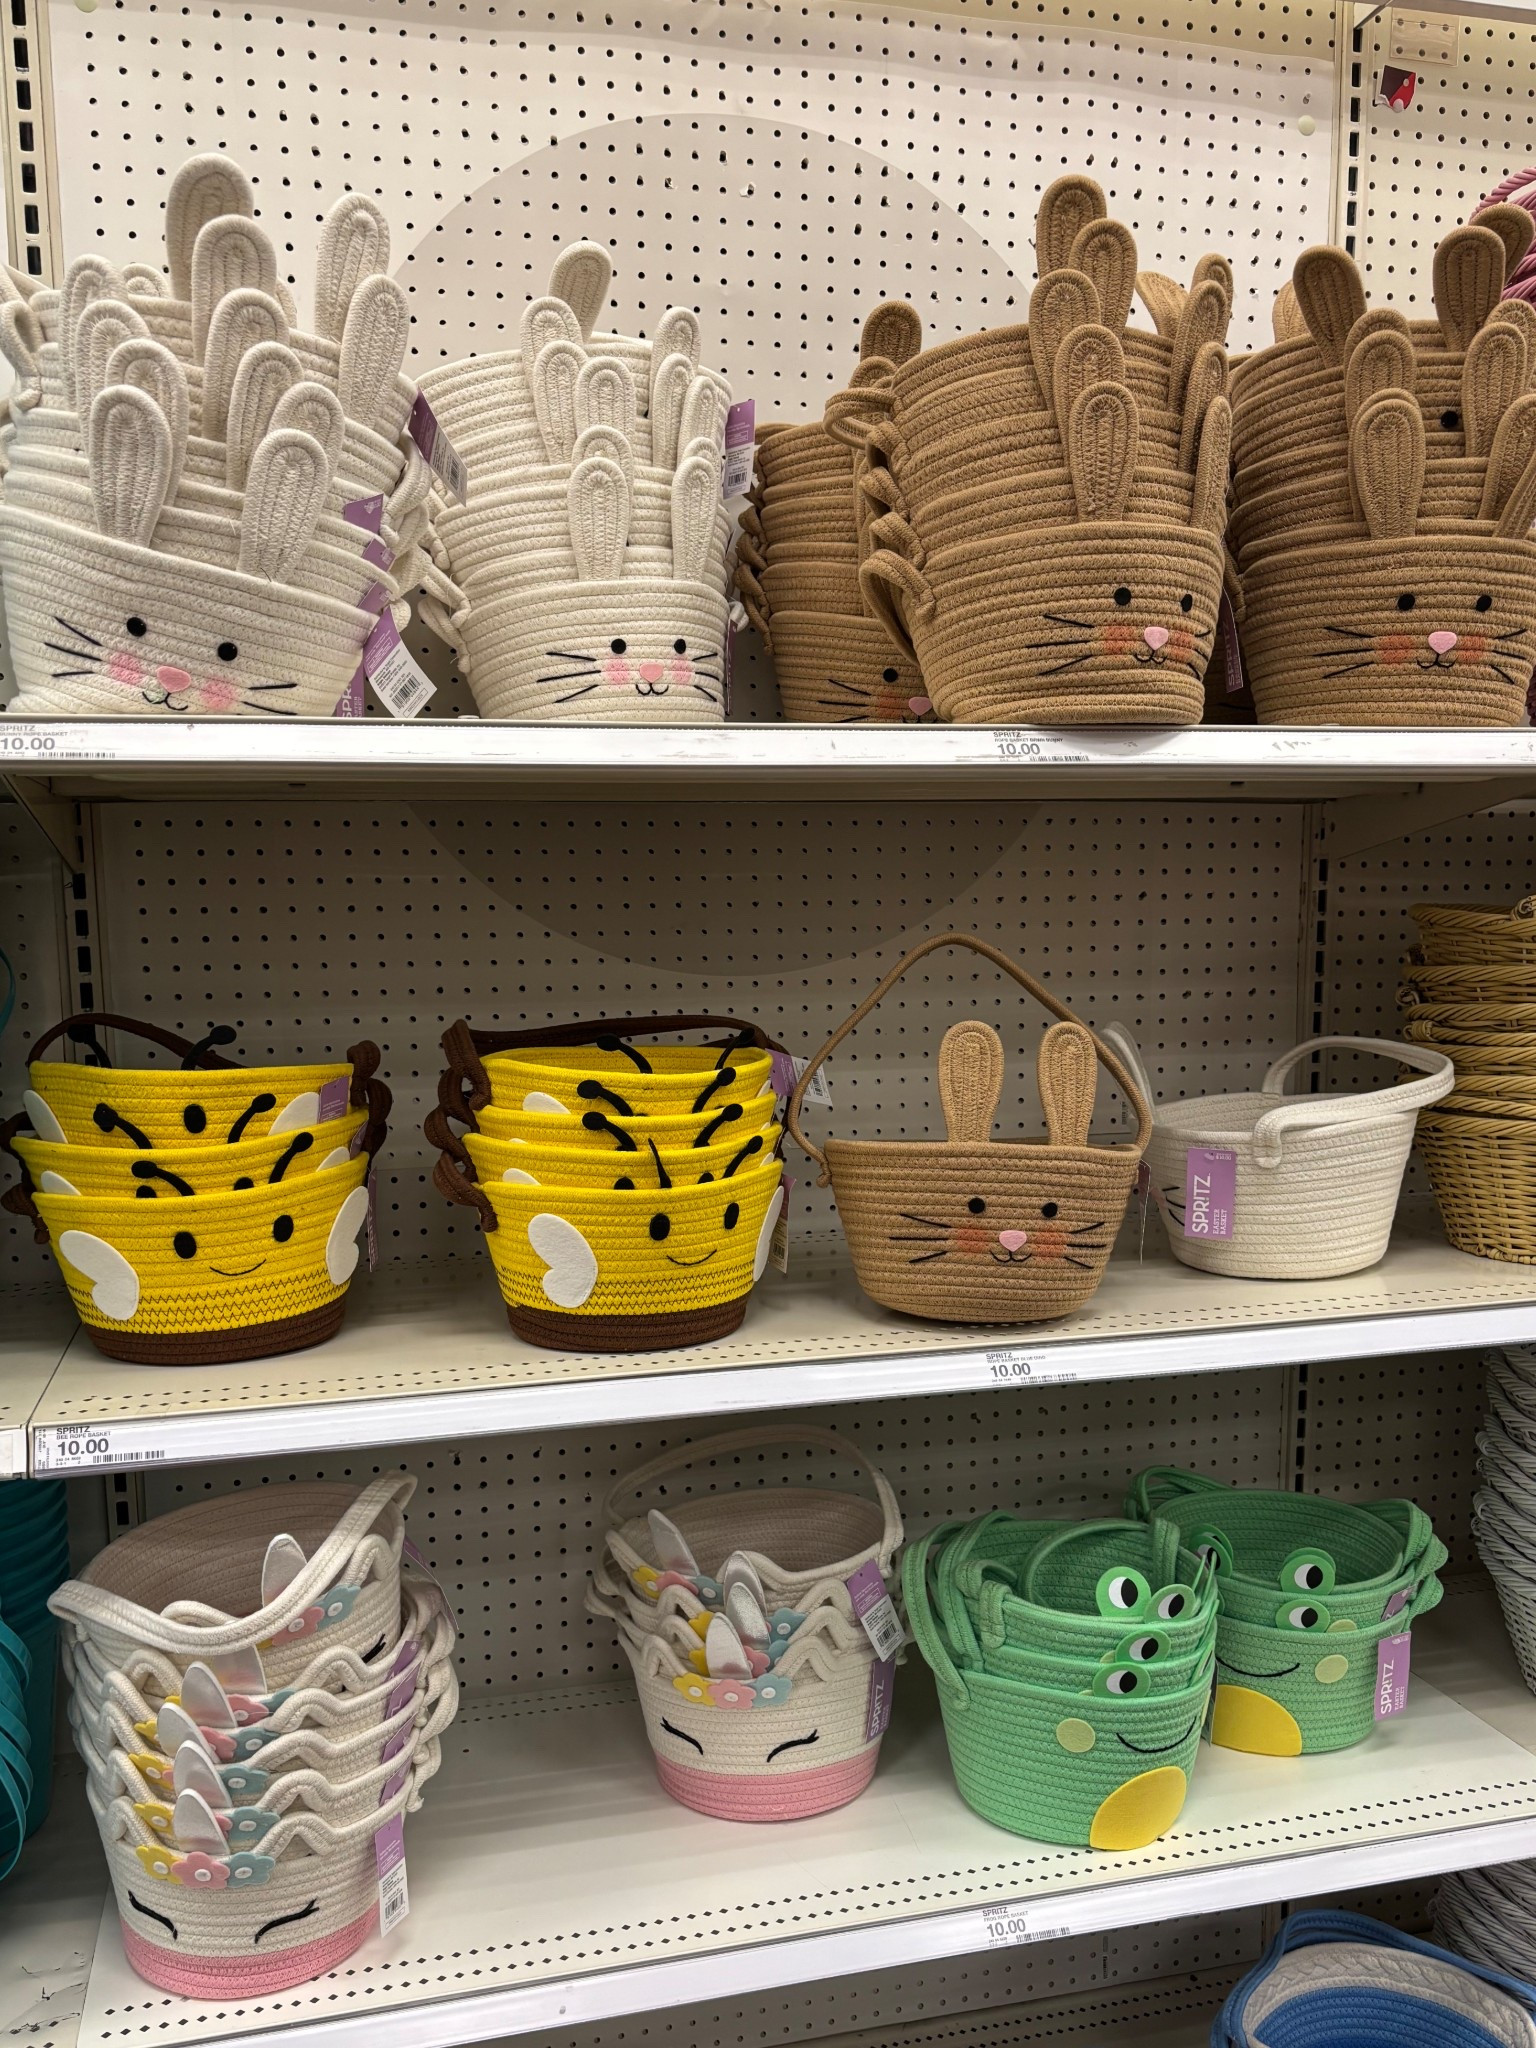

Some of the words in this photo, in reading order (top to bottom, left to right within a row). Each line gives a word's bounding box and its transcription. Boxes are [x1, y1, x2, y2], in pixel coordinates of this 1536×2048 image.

[1, 737, 55, 751] 10.00
[997, 743, 1041, 755] 10.00
[1191, 1173, 1211, 1234] SPRITZ
[1212, 1209, 1220, 1234] EASTER
[1220, 1209, 1228, 1235] BASKET
[986, 1352, 1013, 1360] SPRITZ
[990, 1362, 1031, 1378] 10.00
[56, 1425, 91, 1435] SPRITZ
[57, 1438, 109, 1456] 10.00
[1380, 1657, 1395, 1715] SPRITZ
[870, 1679, 885, 1738] SPRITZ
[982, 1906, 1009, 1917] SPRITZ
[986, 1918, 1026, 1938] 10.00
